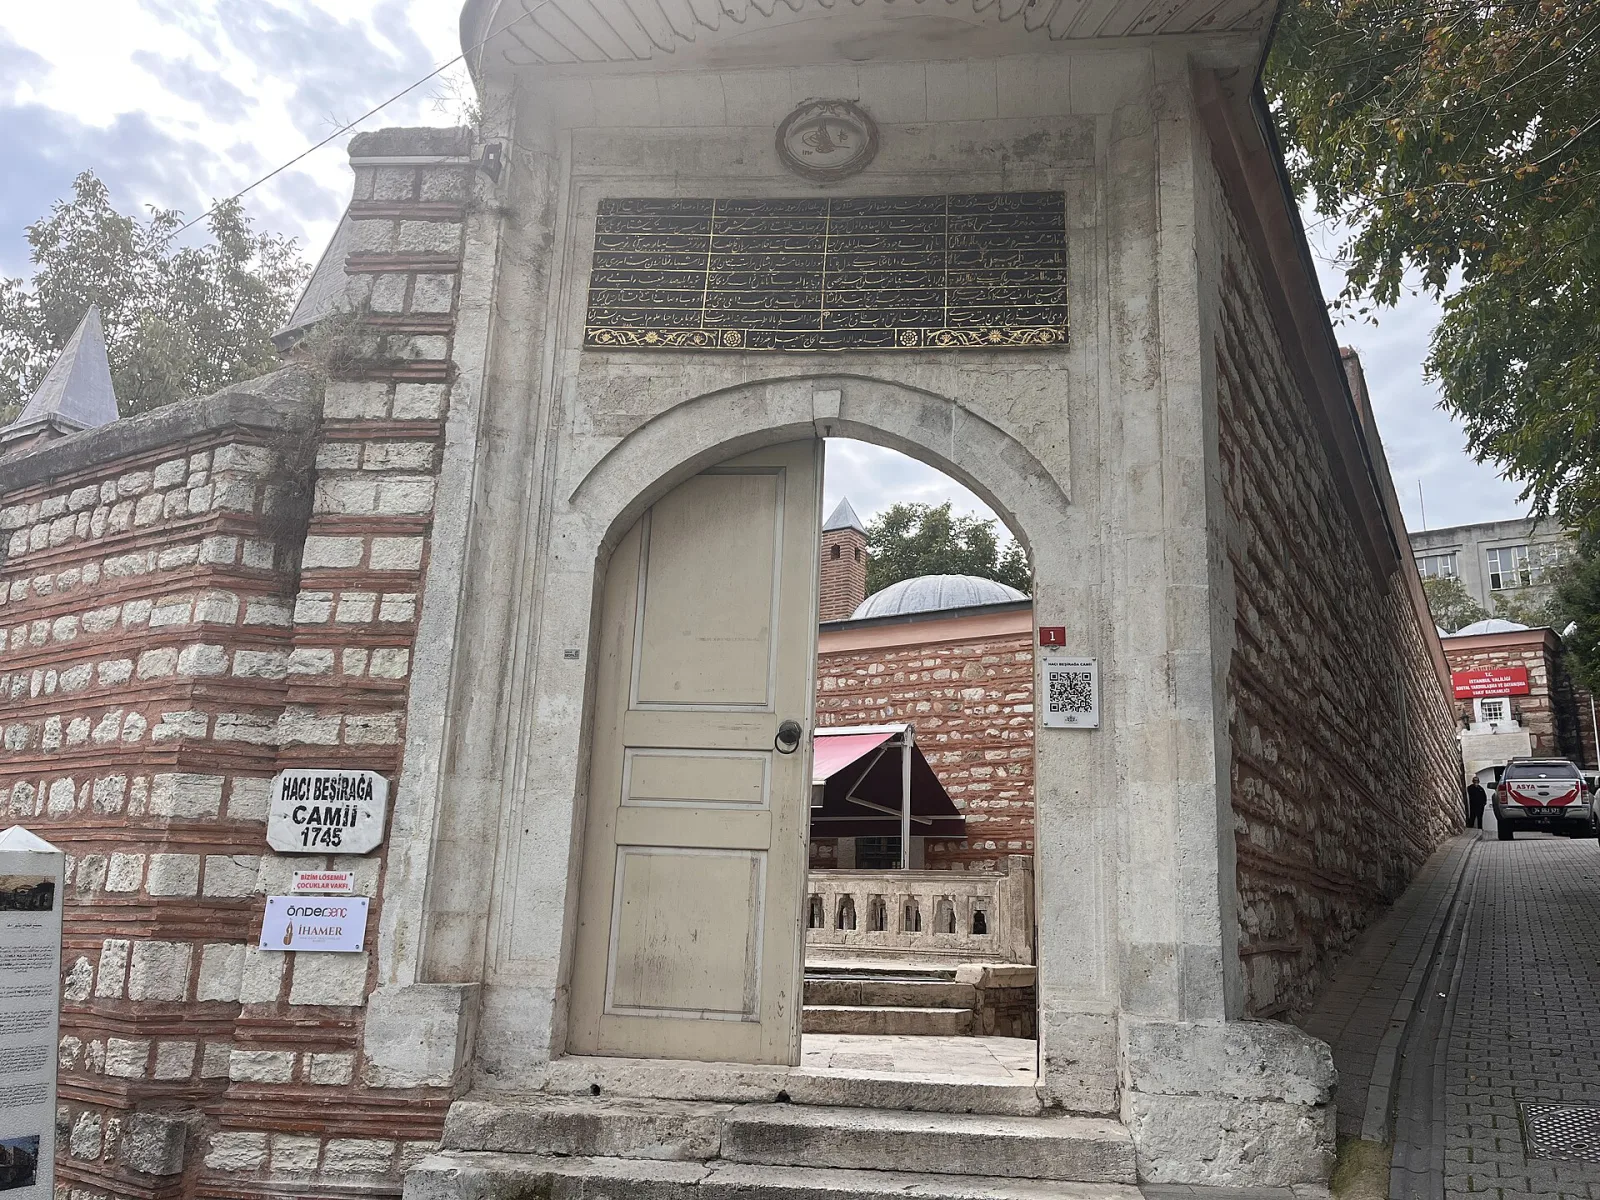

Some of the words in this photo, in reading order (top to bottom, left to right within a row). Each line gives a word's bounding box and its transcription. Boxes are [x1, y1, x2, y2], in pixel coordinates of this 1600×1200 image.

[1050, 631, 1056, 641] 1
[282, 777, 310, 801] HACI
[292, 804, 358, 827] CAMİİ
[301, 827, 343, 847] 1745
[300, 873, 317, 881] BİZİM
[296, 882, 329, 890] ÇOCUKLAR
[330, 882, 348, 890] VAKFI
[298, 924, 342, 936] İHAMER
